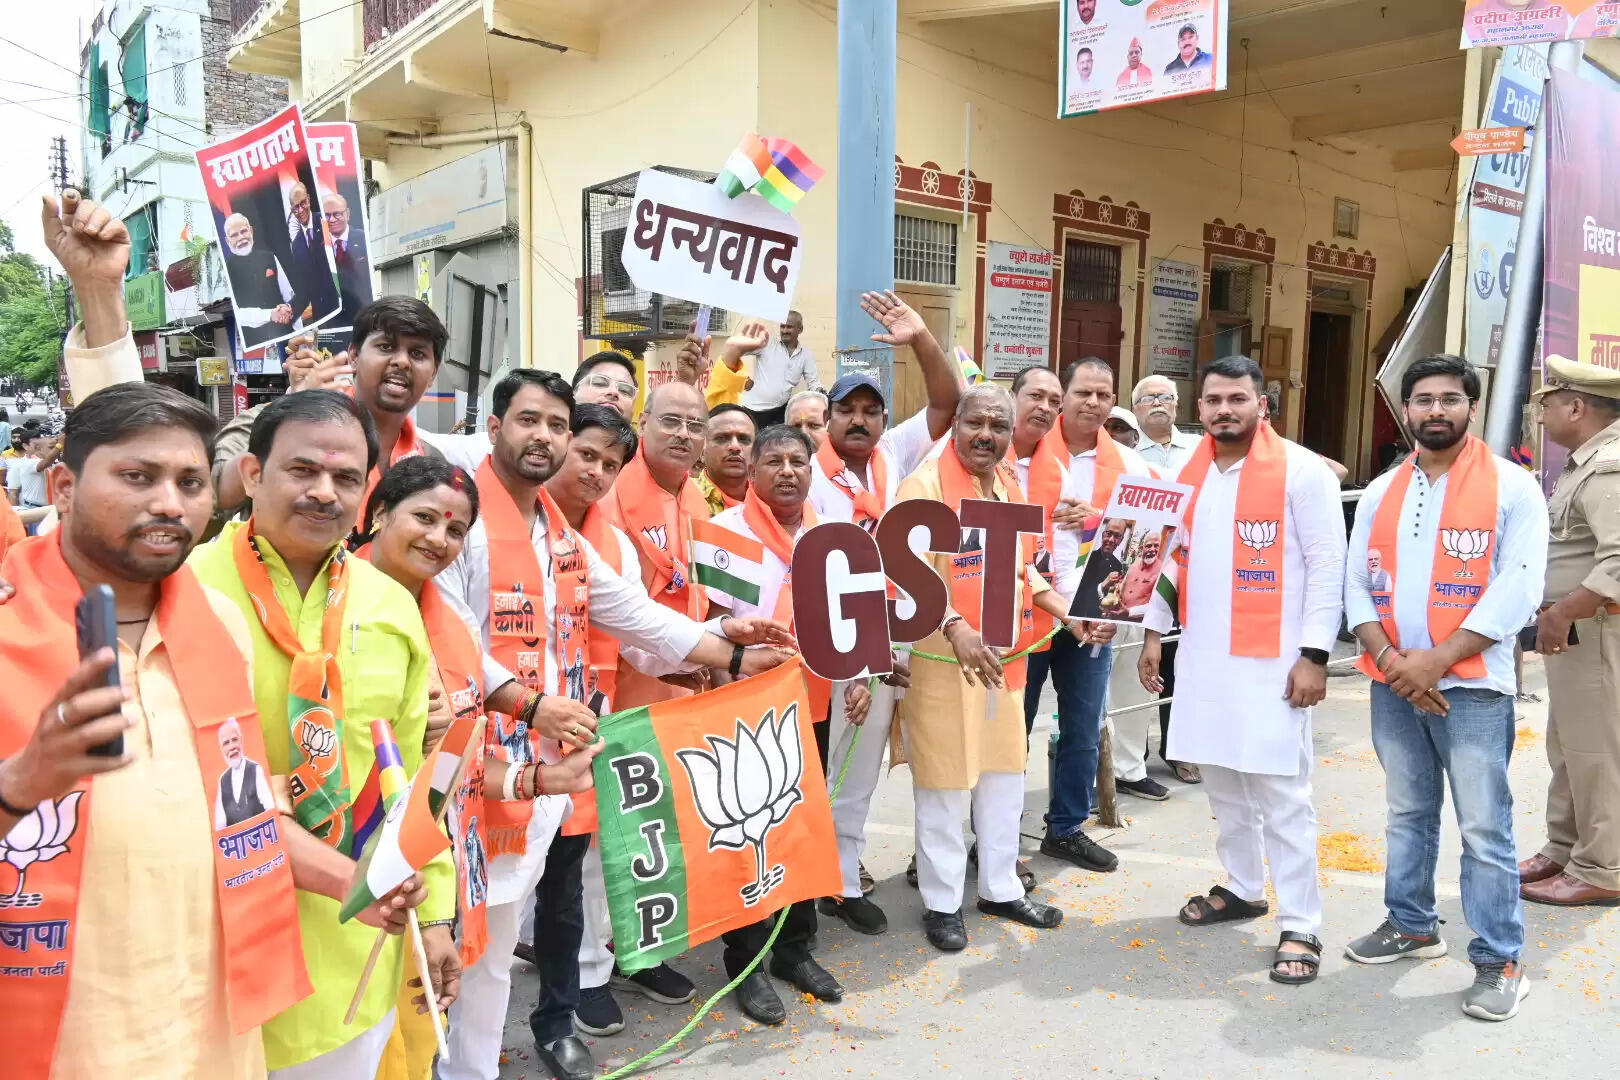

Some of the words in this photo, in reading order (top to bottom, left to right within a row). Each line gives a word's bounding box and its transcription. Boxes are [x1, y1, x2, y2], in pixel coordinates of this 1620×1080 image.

[1502, 87, 1540, 124] Publi
[206, 120, 300, 188] स्वागतम
[633, 198, 799, 293] धन्यवाद
[1582, 215, 1616, 256] विश्व
[1117, 483, 1184, 513] स्वागतम
[791, 498, 1044, 682] GST
[1235, 568, 1275, 582] भाजपा
[1434, 582, 1482, 598] भाजपा
[218, 816, 279, 860] भाजपा
[611, 752, 677, 952] BJP
[0, 919, 70, 952] जपा
[38, 960, 67, 977] पार्टी
